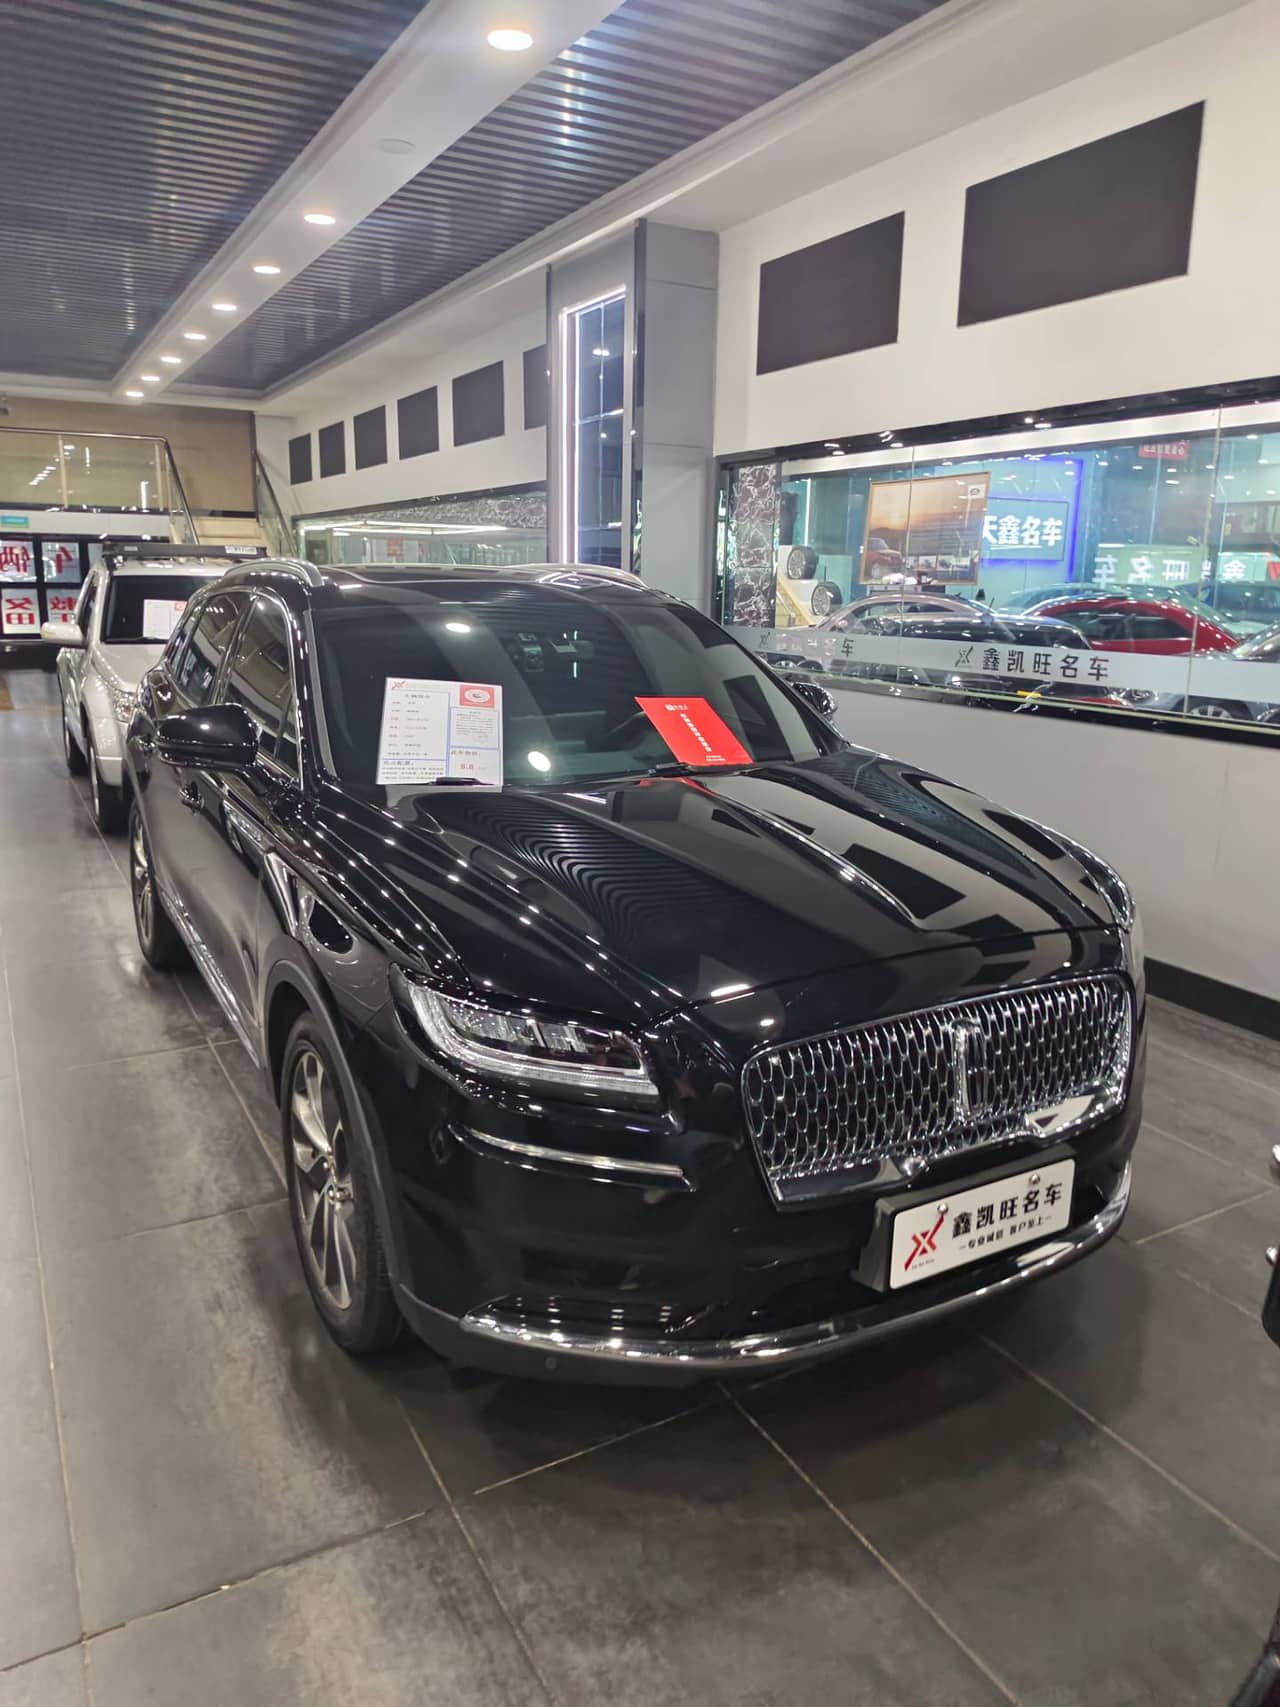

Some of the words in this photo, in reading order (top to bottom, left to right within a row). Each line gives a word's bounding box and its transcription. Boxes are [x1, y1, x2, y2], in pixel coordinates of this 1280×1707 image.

[982, 647, 1109, 681] 鑫凯旺名车
[952, 1182, 1063, 1239] 鑫凯旺名车
